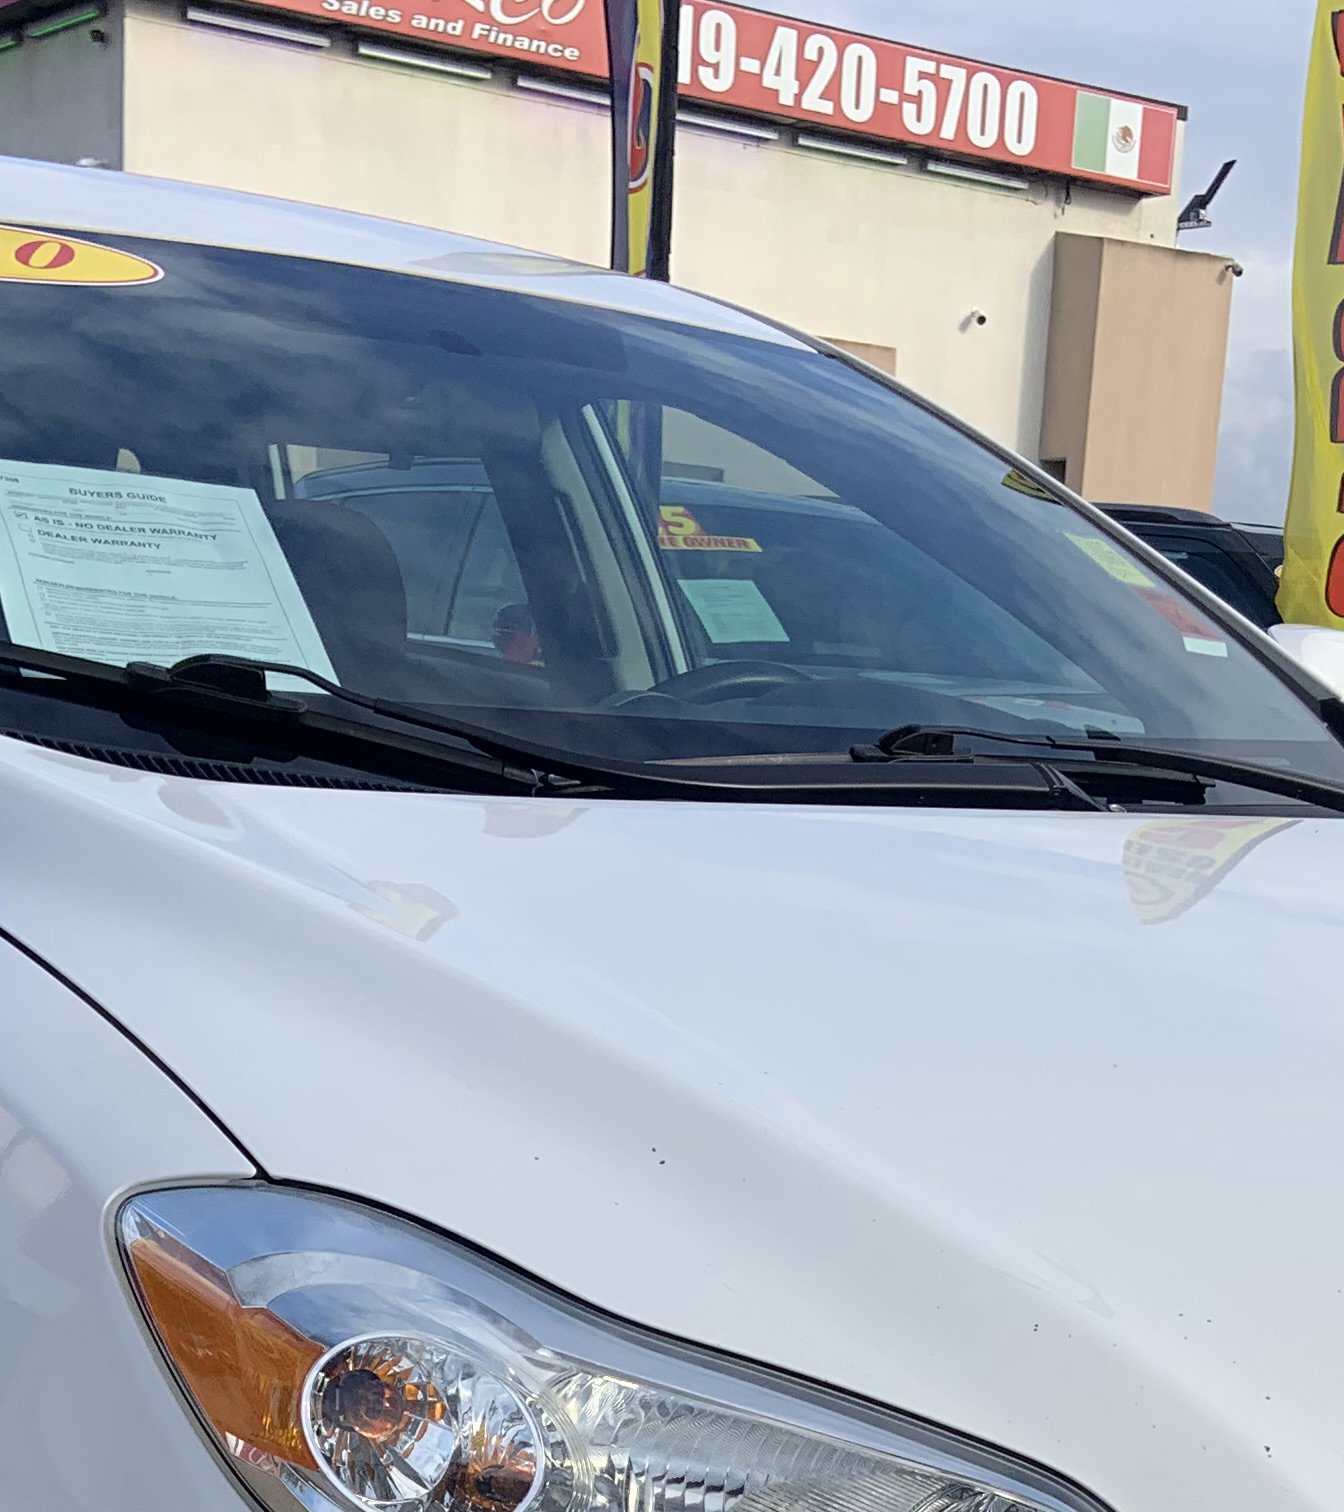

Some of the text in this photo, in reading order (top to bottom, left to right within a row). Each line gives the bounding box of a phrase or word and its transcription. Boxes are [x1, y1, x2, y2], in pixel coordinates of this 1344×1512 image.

[321, 0, 581, 61] Sales and Finance
[68, 487, 124, 500] BUYERS
[127, 491, 167, 503] GUIDE
[34, 515, 52, 525] AS
[52, 519, 65, 527] IS
[75, 521, 94, 531] NO
[96, 523, 146, 534] DEALER
[148, 527, 217, 541] WARRANTY
[37, 529, 161, 550] DEALER WARRANTY
[682, 536, 751, 549] OWNER
